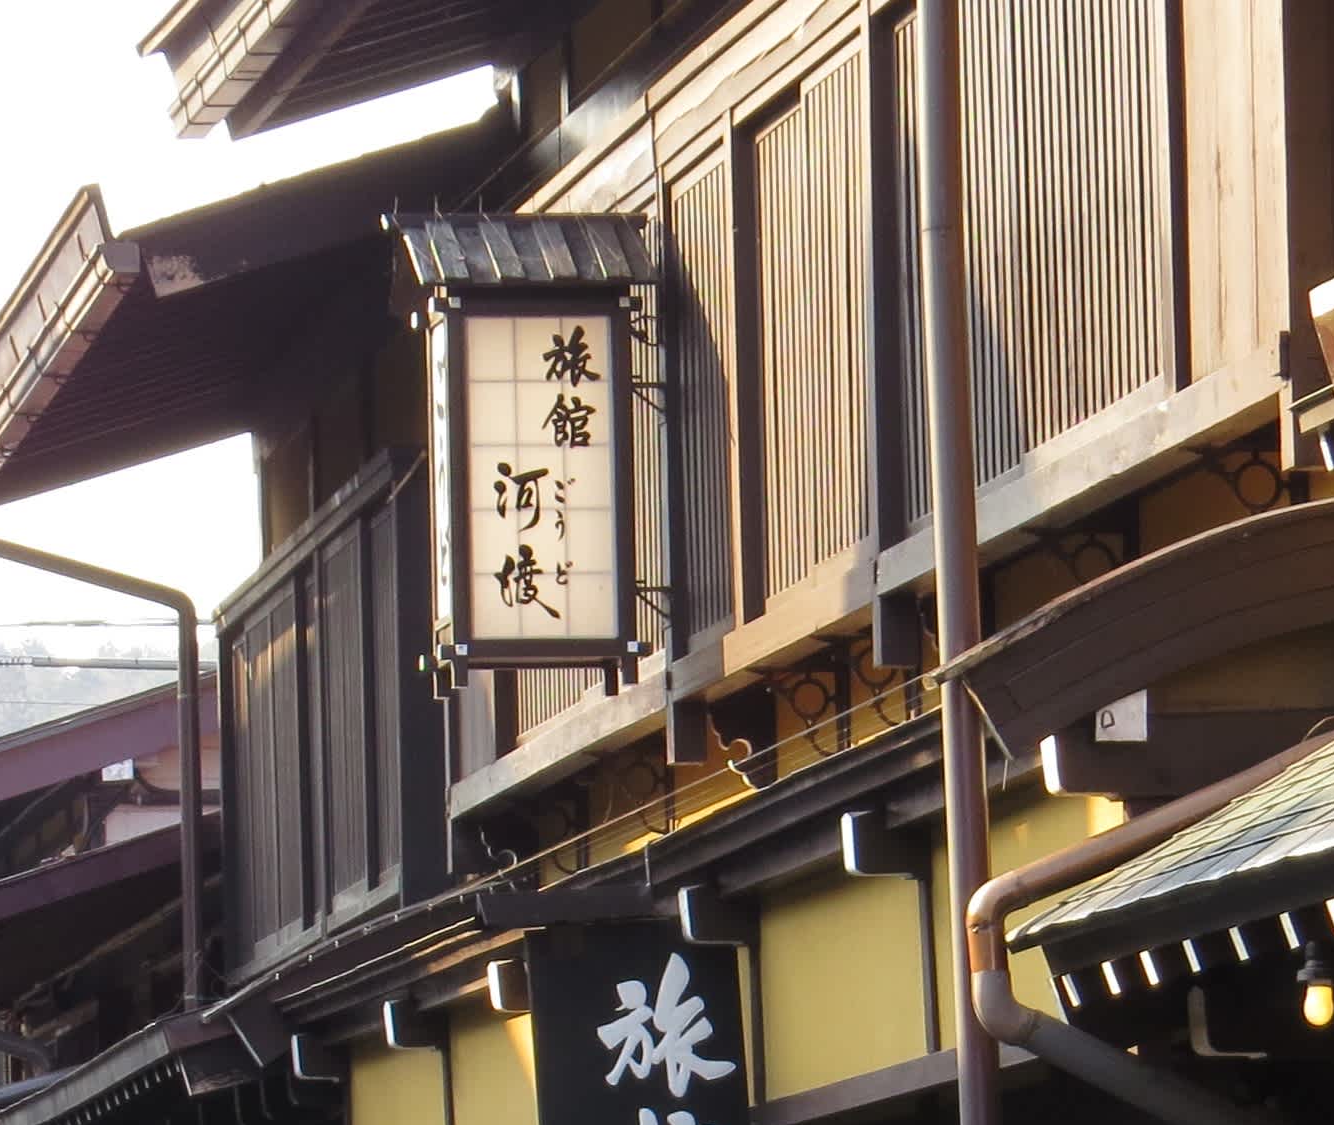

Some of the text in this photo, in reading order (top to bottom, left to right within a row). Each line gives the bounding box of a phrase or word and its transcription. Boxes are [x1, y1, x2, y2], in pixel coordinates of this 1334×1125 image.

[542, 325, 601, 448] 旅館
[554, 477, 576, 585] ごうど
